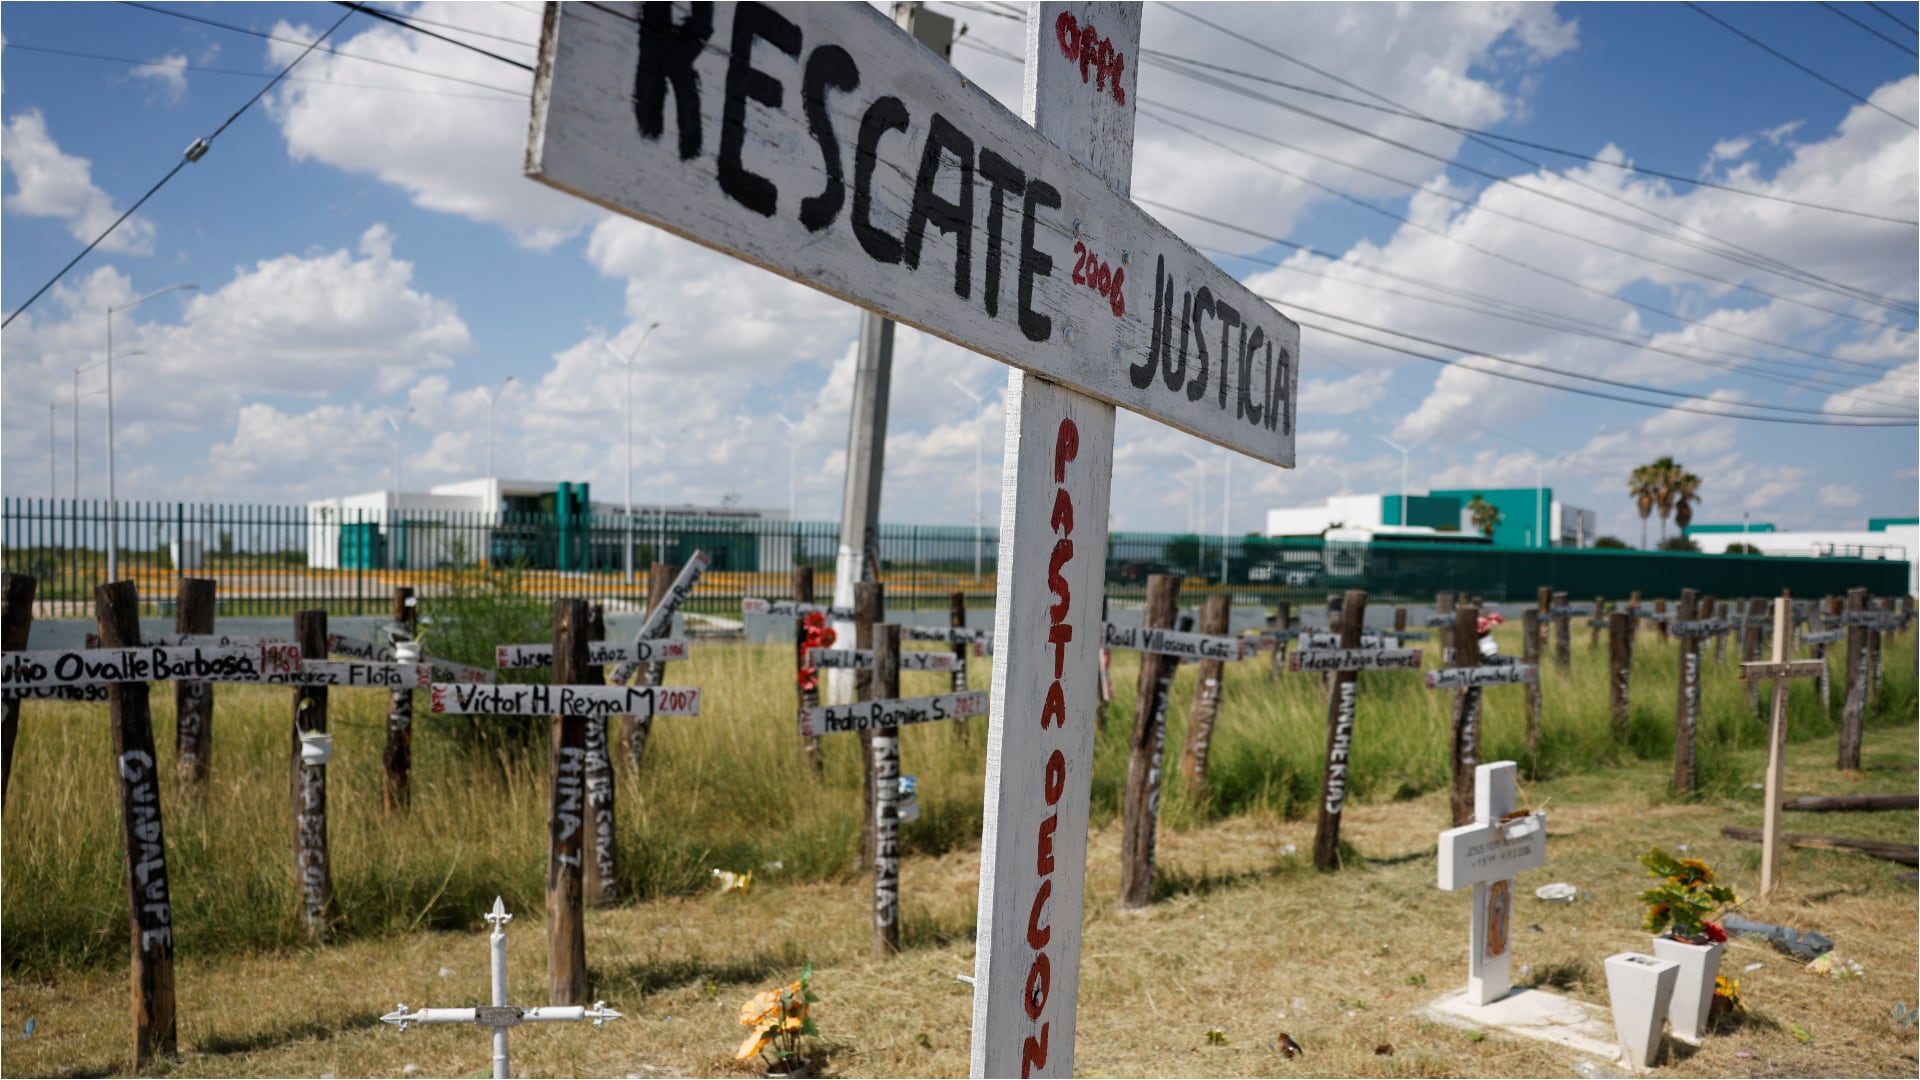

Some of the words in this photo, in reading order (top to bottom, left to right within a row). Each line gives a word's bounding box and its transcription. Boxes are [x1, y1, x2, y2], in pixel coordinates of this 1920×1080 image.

[634, 1, 1062, 342] RESCATE
[1130, 254, 1291, 436] JUSTICIA
[1040, 417, 1079, 730] PASTA
[152, 648, 258, 680] Barbosa
[350, 665, 402, 685] Flota
[637, 642, 652, 662] D
[532, 684, 554, 714] H.
[560, 688, 623, 716] Reyna
[626, 688, 654, 716] M
[659, 690, 697, 712] 2007
[825, 709, 868, 732] Pedro
[557, 747, 584, 840] MINA
[1037, 749, 1066, 878] DE
[119, 750, 173, 951] GUADALUPE
[558, 849, 582, 868] 7
